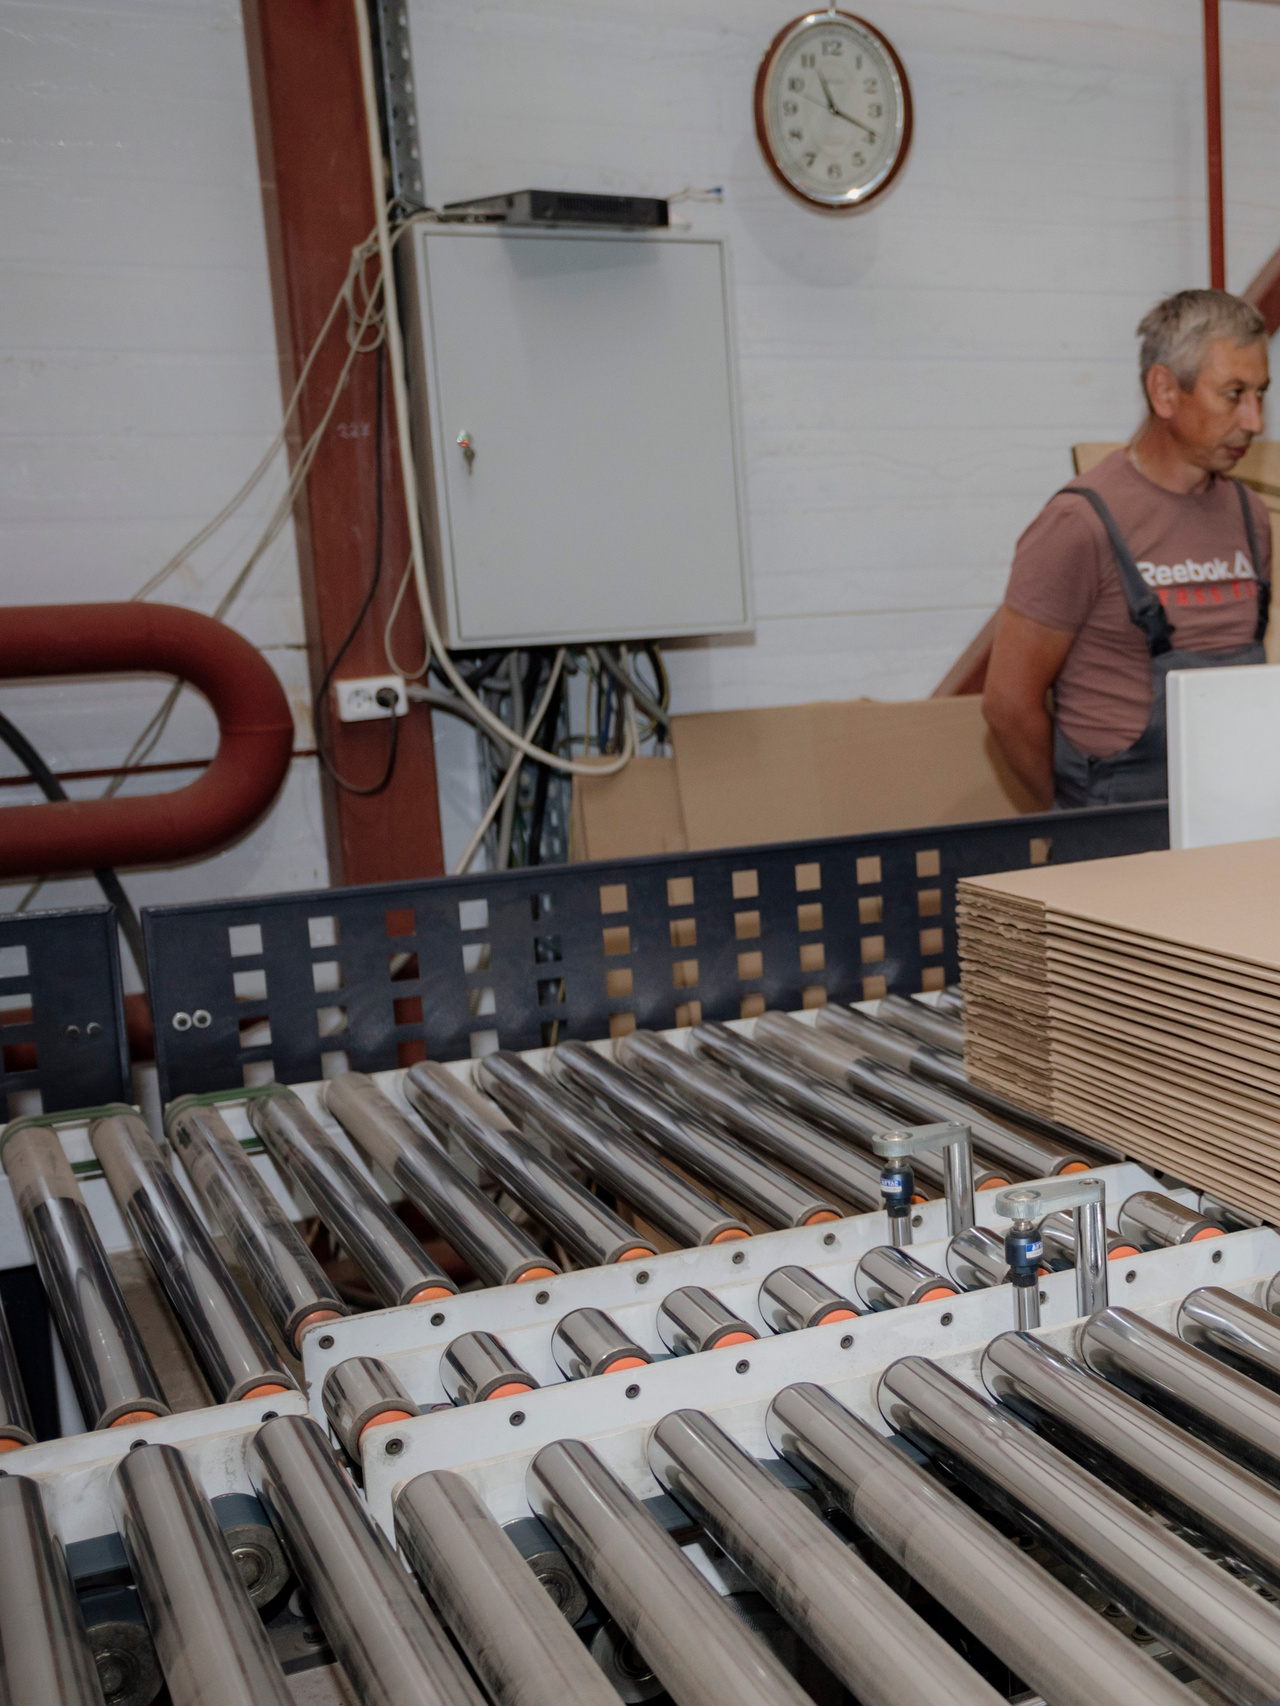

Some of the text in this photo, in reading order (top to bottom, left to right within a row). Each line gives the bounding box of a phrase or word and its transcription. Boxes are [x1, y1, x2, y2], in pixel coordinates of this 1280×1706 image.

[821, 39, 843, 57] 12
[801, 53, 816, 70] 11
[855, 54, 863, 70] 1
[788, 77, 805, 93] 10
[863, 78, 878, 95] 2
[783, 100, 798, 117] 9
[868, 102, 883, 119] 3
[789, 129, 803, 143] 8
[804, 152, 817, 167] 7
[853, 152, 866, 167] 5
[827, 163, 842, 180] 6
[1136, 558, 1234, 587] Reebok
